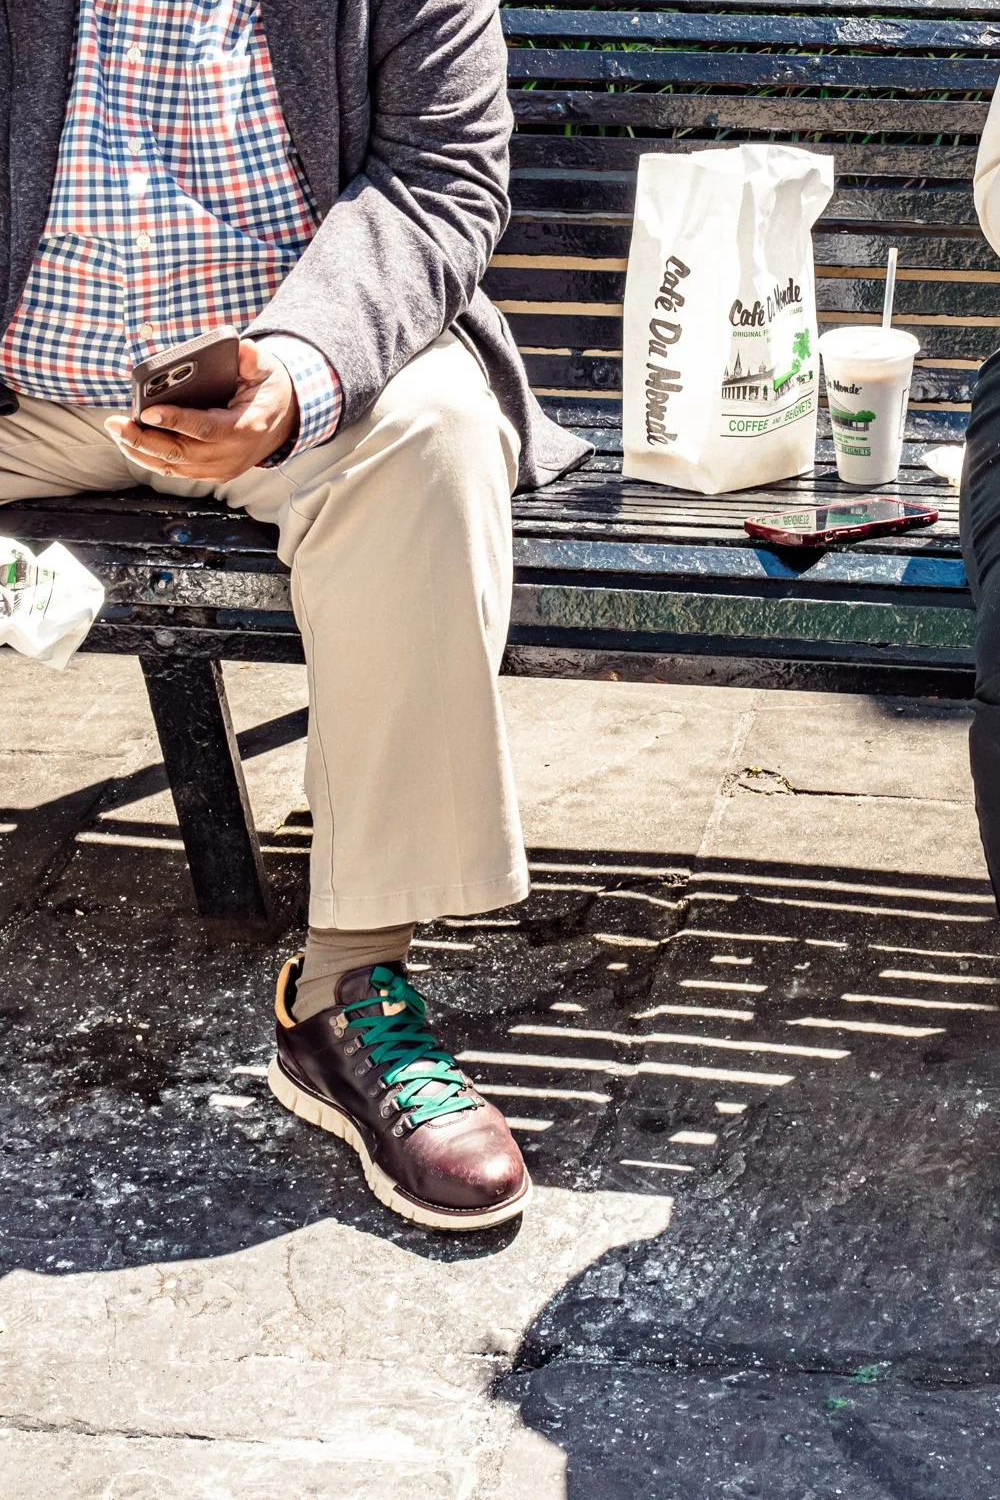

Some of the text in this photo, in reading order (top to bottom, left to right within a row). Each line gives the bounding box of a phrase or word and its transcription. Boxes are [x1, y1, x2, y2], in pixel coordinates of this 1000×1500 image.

[728, 298, 765, 327] Café
[732, 330, 762, 338] ORIGINAL
[645, 255, 691, 446] Café Du Monde
[833, 379, 861, 395] Monde
[728, 397, 812, 432] COFFEE AND BEIGNETS
[841, 445, 871, 456] BEIGNETS
